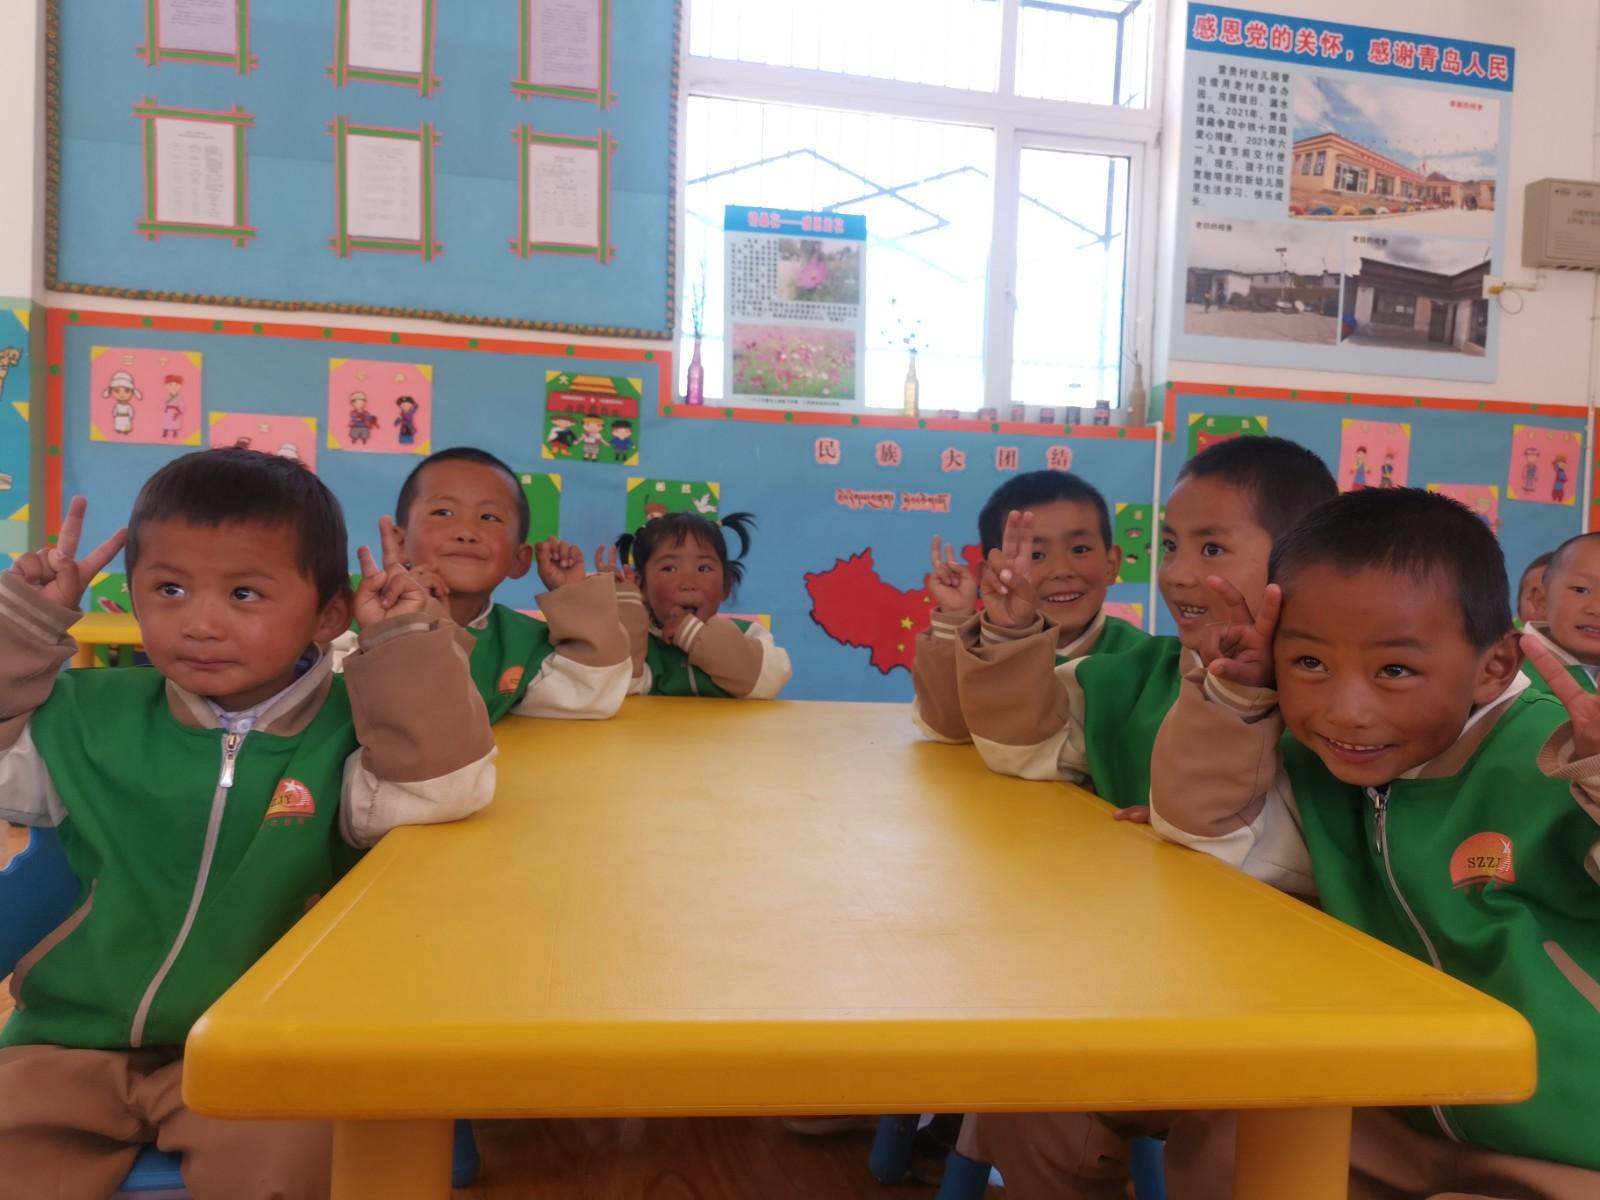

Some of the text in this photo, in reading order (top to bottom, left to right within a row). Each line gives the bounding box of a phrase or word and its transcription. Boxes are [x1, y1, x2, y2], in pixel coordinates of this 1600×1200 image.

[1193, 14, 1508, 80] 感恩党的关怀，感谢青岛人民
